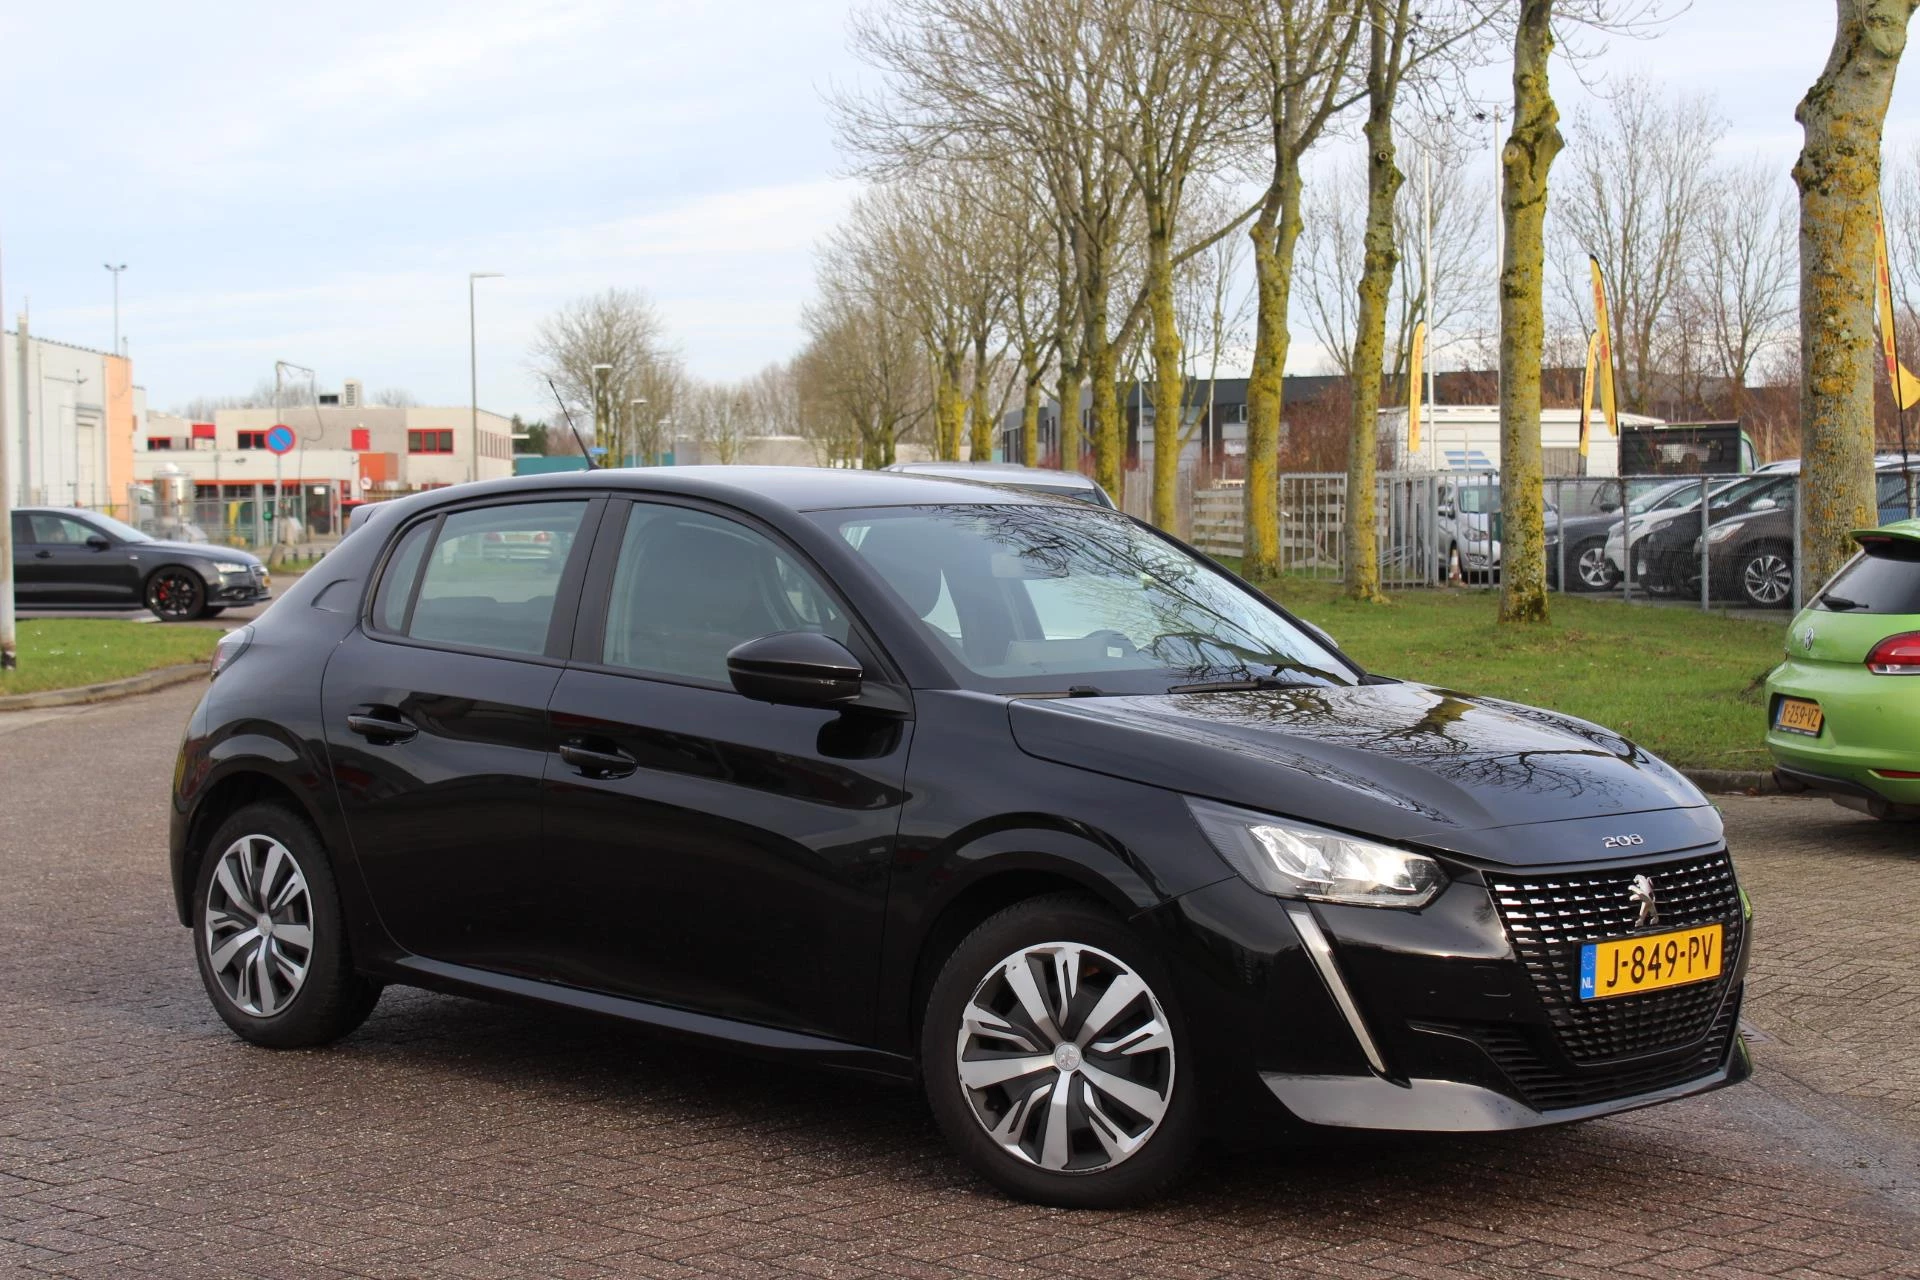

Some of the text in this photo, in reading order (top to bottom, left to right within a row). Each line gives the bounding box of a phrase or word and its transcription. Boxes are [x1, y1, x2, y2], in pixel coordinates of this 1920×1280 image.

[1602, 833, 1644, 849] 208
[1606, 933, 1714, 988] J-849-PV
[1581, 977, 1593, 989] NL
